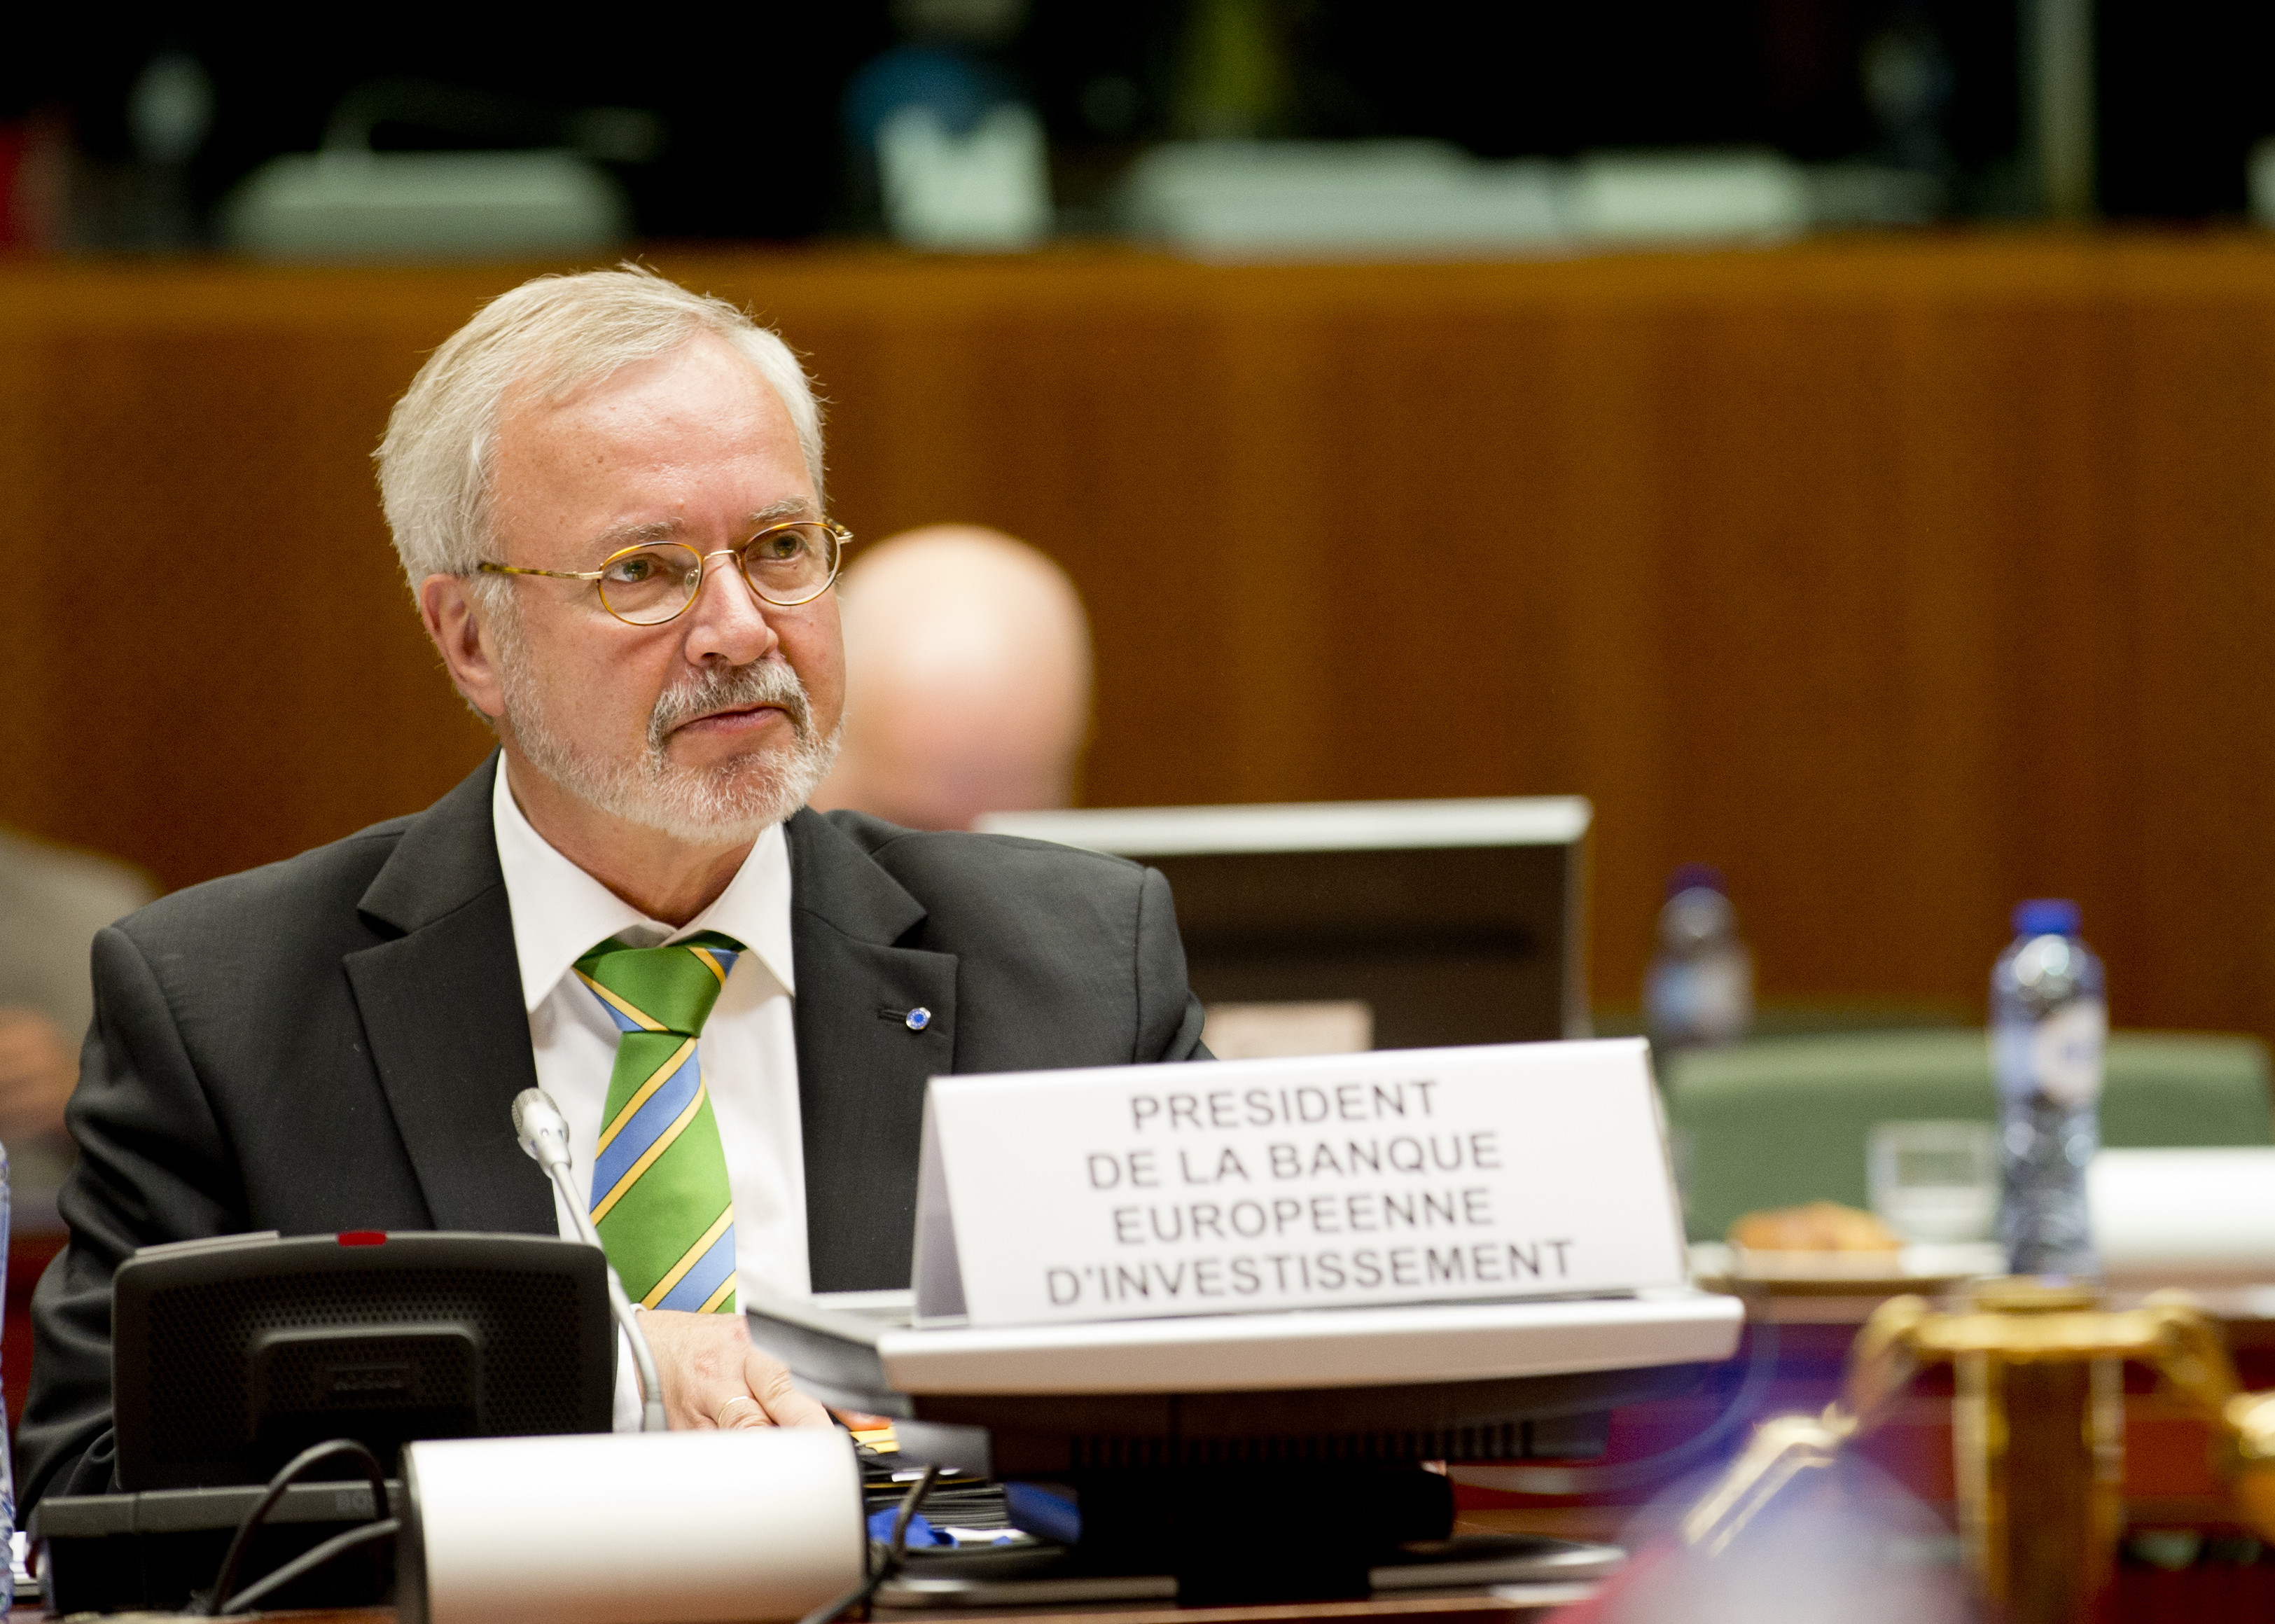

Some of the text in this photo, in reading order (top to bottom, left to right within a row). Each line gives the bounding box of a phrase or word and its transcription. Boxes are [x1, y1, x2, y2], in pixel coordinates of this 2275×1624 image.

[1130, 1080, 1438, 1132] PRESIDENT
[1087, 1132, 1501, 1189] DE LA BANQUE
[1113, 1188, 1493, 1244] EUROPEENNE
[1046, 1239, 1572, 1306] D'INVESTISSEMENT
